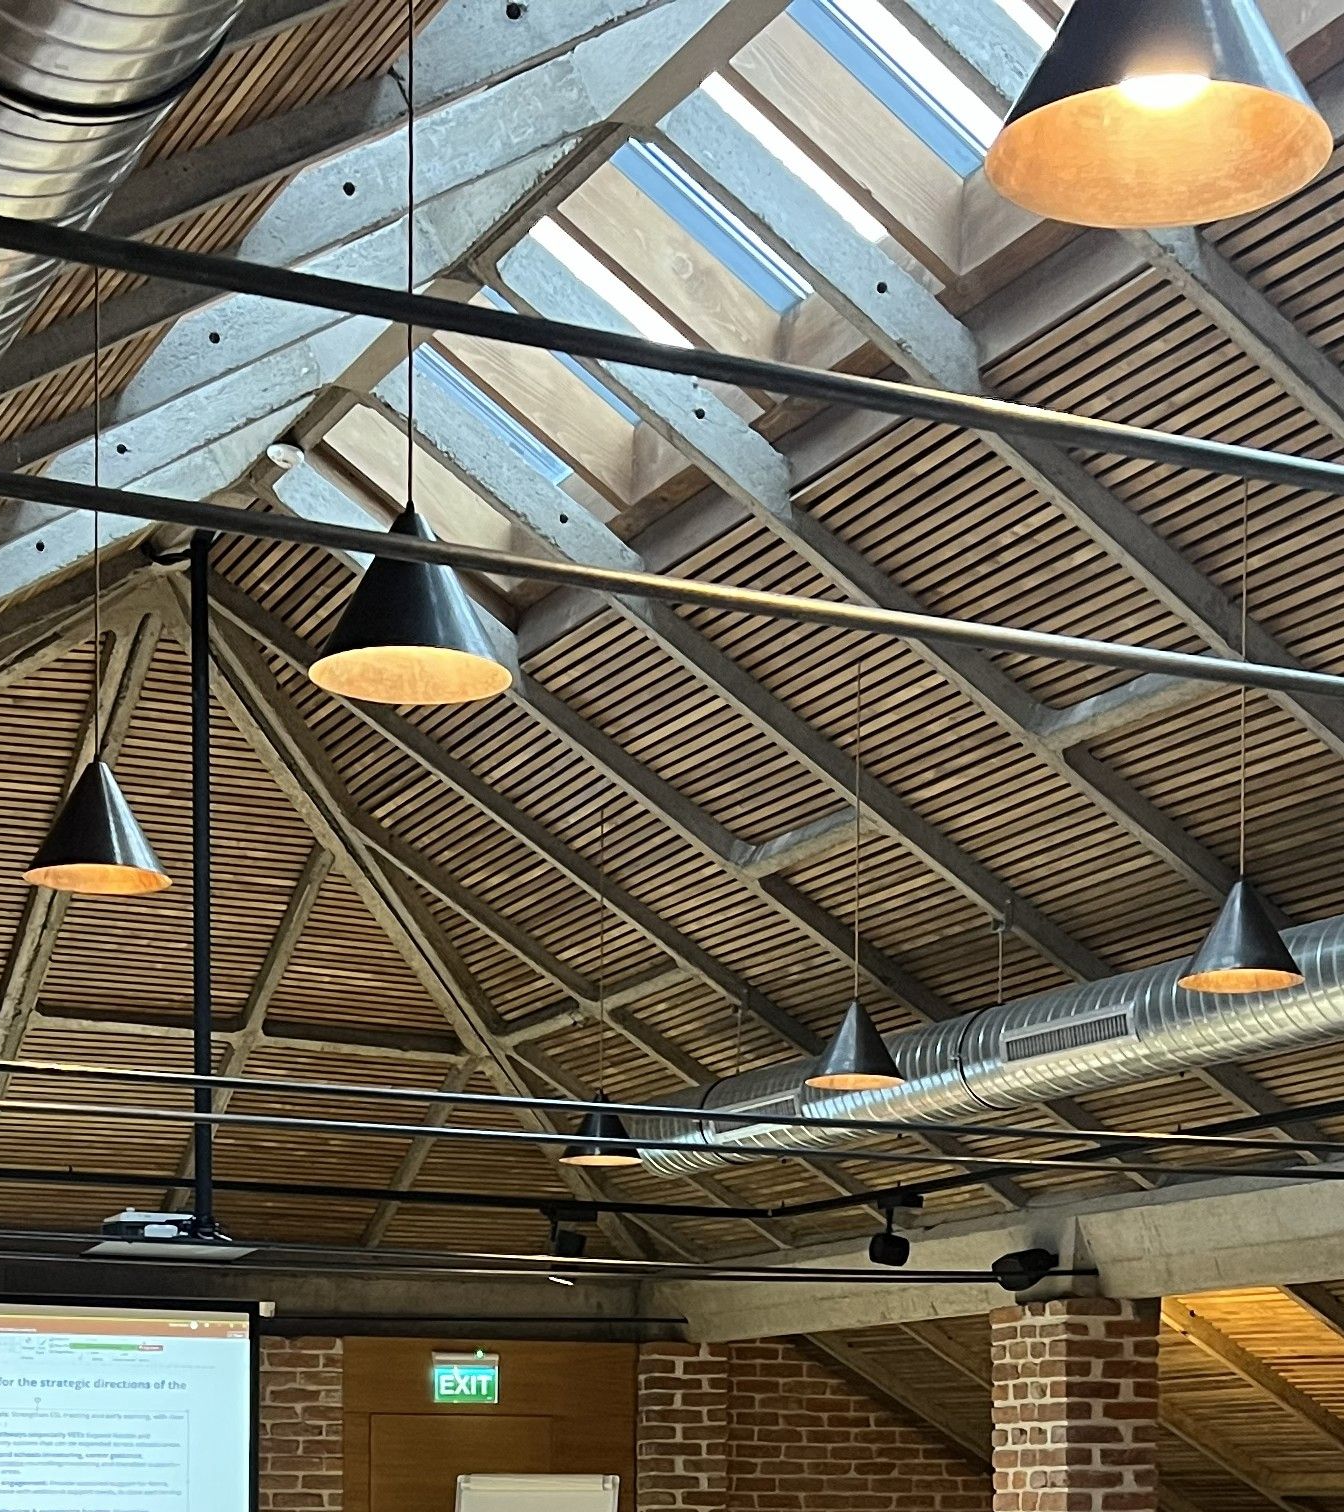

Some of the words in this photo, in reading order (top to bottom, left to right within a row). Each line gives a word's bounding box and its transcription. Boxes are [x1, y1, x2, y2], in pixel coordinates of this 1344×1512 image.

[17, 1376, 38, 1388] the
[40, 1377, 91, 1390] strategic
[93, 1379, 151, 1390] directions
[154, 1379, 165, 1390] of
[167, 1380, 188, 1391] the
[439, 1374, 493, 1395] EXIT
